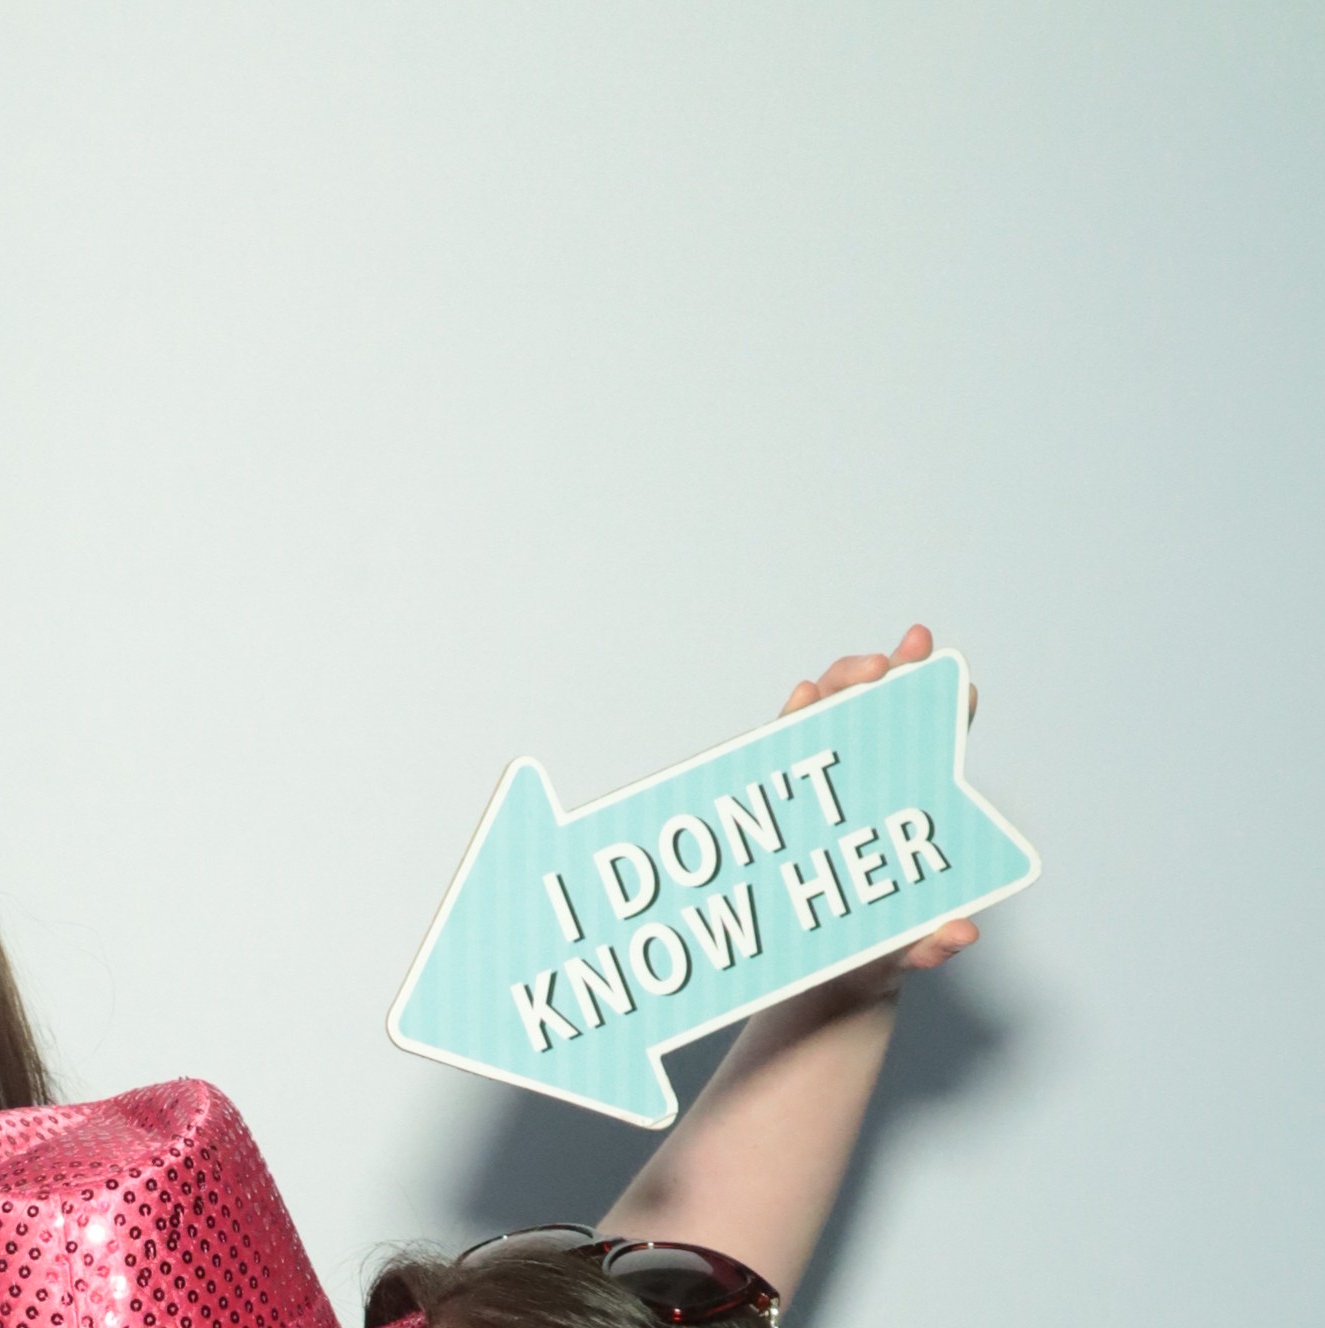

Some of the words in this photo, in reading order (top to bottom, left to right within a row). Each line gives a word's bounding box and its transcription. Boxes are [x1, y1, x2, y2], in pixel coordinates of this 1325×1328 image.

[510, 882, 763, 1052] KNOW
[780, 807, 950, 931] HER
[543, 872, 585, 942] I
[593, 749, 846, 921] DON'T
